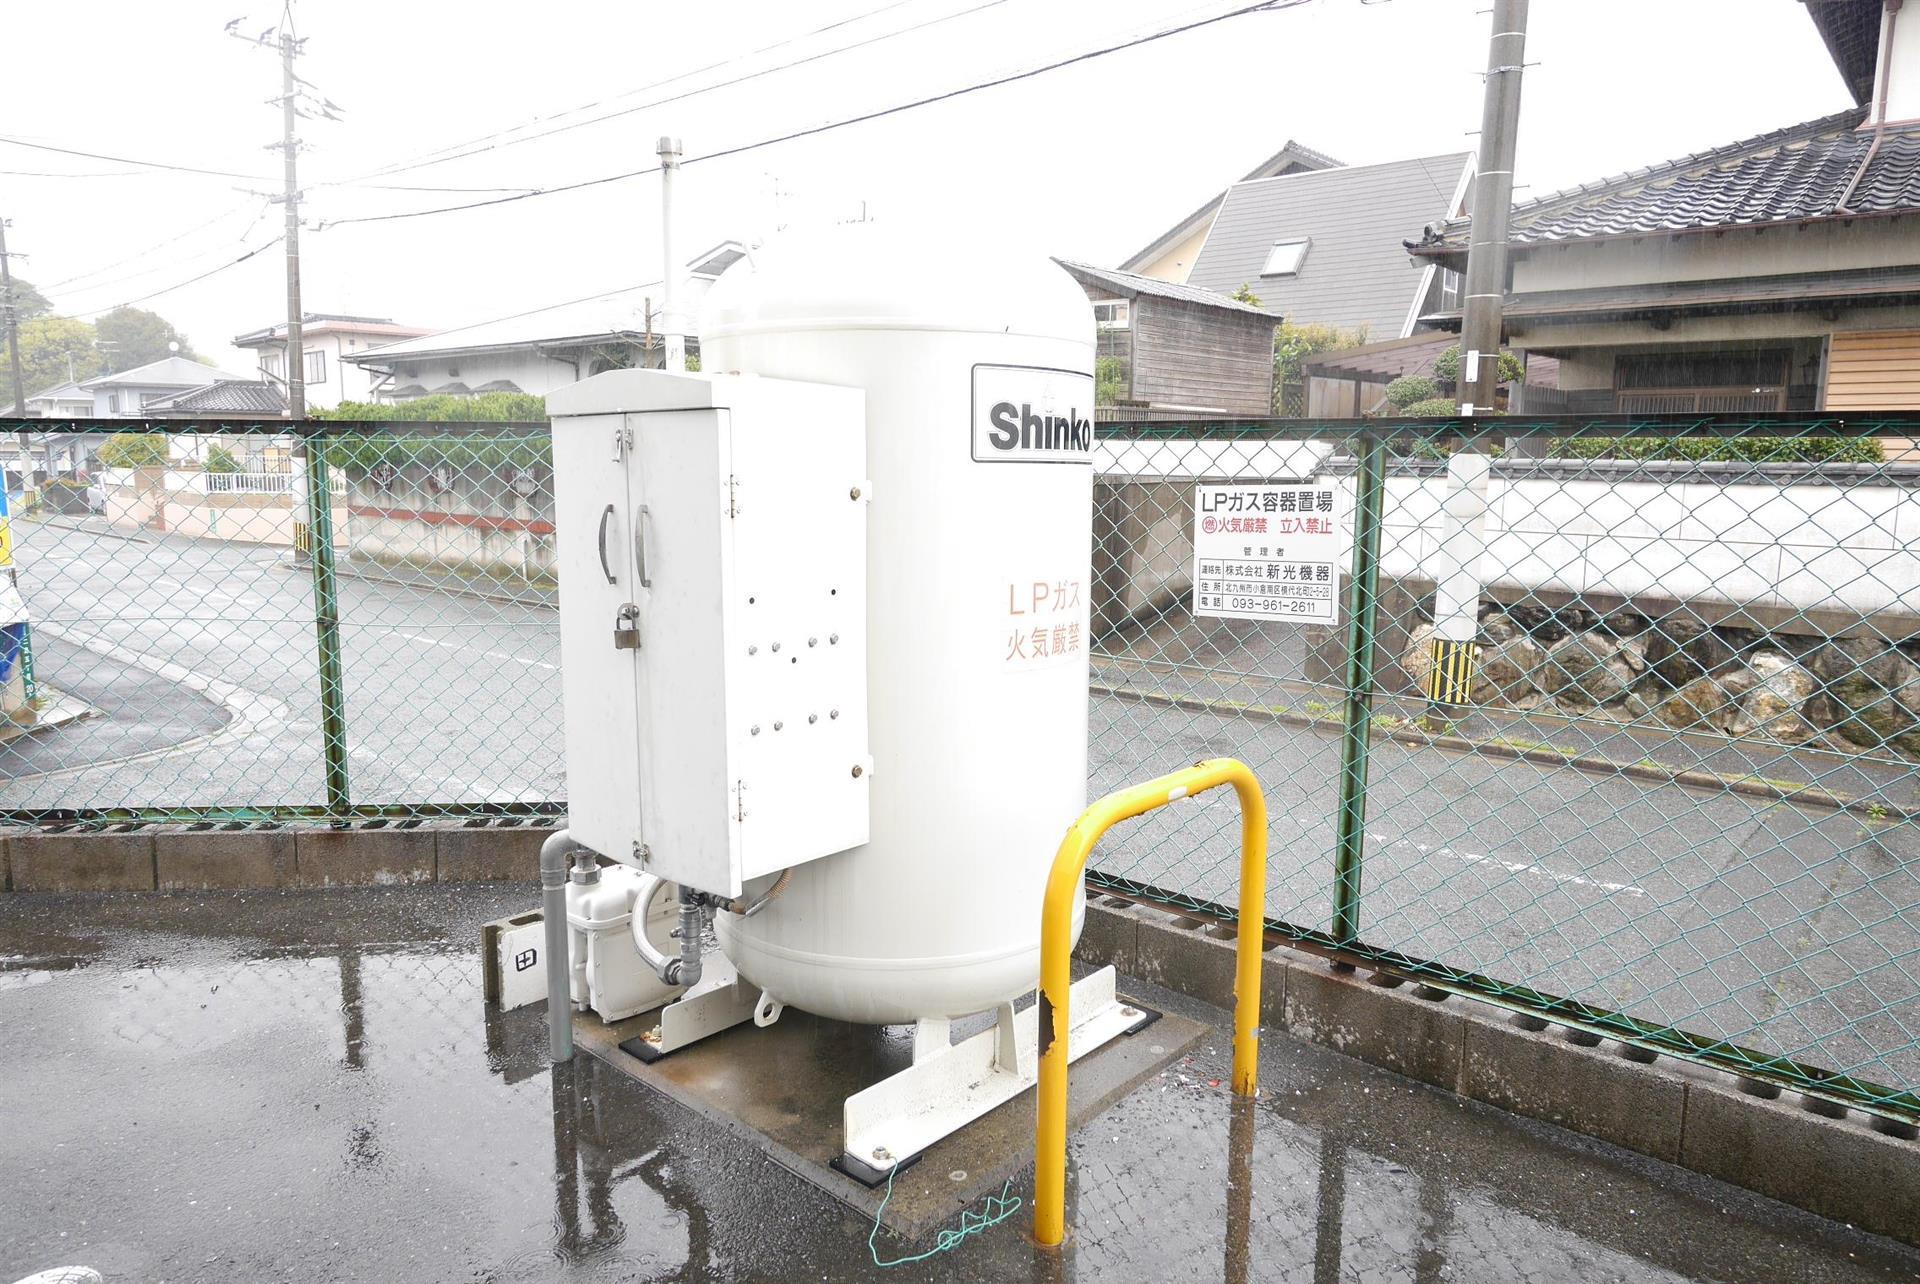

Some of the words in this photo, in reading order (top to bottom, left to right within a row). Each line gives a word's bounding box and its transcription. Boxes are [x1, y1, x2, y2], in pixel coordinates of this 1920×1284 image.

[988, 401, 1091, 453] Shinko
[1202, 491, 1334, 513] LPガス容器置場
[1218, 517, 1267, 534] 火気厳禁
[1280, 518, 1333, 534] 立入禁止
[1009, 580, 1081, 615] LPガス
[1232, 597, 1315, 613] 093-961-2611
[1006, 622, 1081, 661] 火気厳禁
